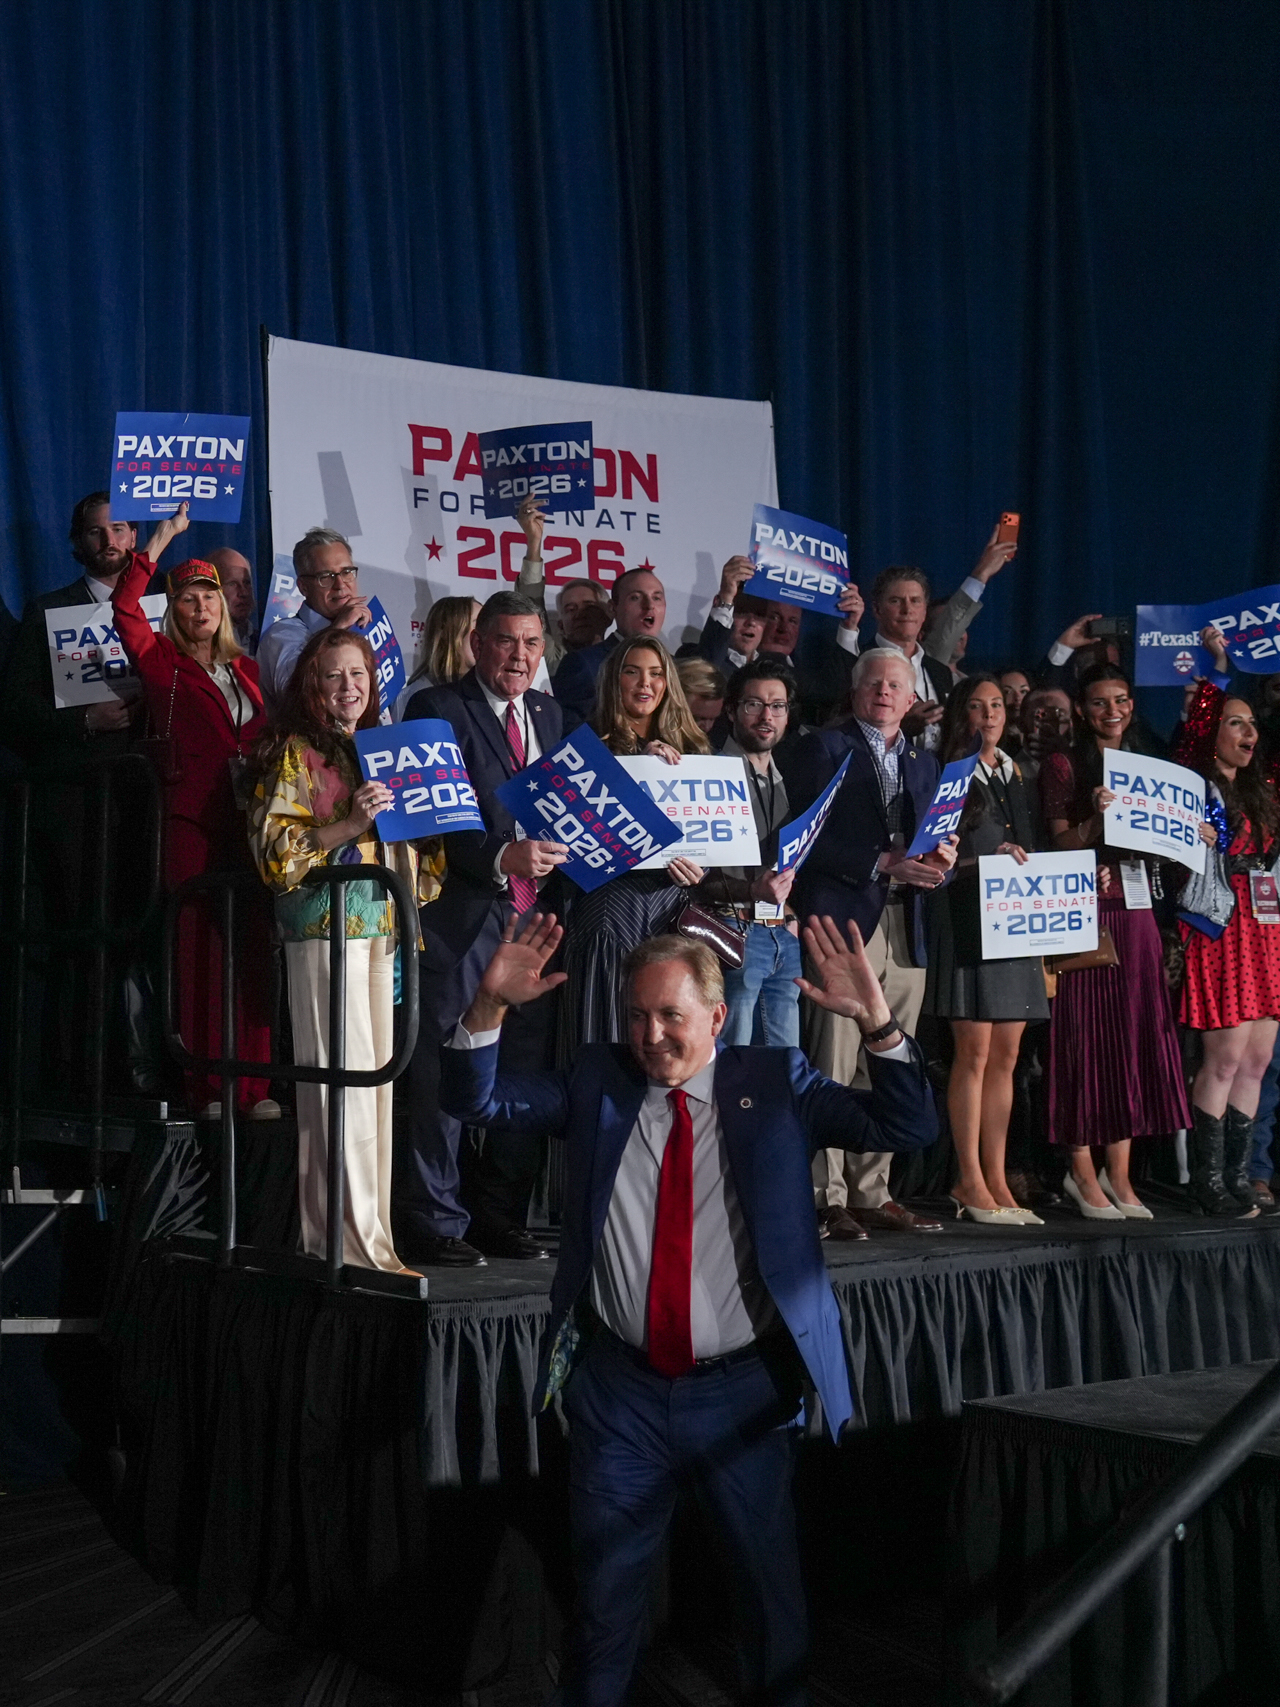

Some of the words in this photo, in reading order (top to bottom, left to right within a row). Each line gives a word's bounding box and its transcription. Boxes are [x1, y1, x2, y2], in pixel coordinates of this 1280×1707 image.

[117, 435, 244, 461] PAXTON
[482, 440, 590, 469] PAXTON
[116, 462, 151, 472] FOR
[160, 462, 242, 475] SENATE
[408, 423, 659, 503] PAON
[132, 475, 218, 499] 2026
[498, 474, 571, 499] 2026
[456, 525, 626, 590] 2026
[755, 522, 848, 569] PAXTON
[766, 563, 837, 596] 2026
[1209, 602, 1280, 635] PAX
[57, 650, 98, 663] FOR
[364, 742, 466, 777] PAXT
[388, 773, 422, 789] OR
[638, 779, 747, 802] AXTON
[933, 776, 973, 804] PAX
[1109, 770, 1205, 818] PAXTON
[402, 782, 478, 815] 202
[552, 742, 661, 855] PAXTON
[666, 805, 750, 816] SENATE
[929, 805, 956, 815] FOR
[1112, 794, 1147, 808] OR
[1157, 802, 1202, 826] SENAT
[541, 762, 577, 803] FOR
[581, 810, 638, 866] SENATE
[931, 809, 962, 835] 20
[1130, 809, 1195, 847] 2026
[534, 794, 614, 868] 2026
[985, 872, 1094, 899] PAXTON
[986, 901, 1022, 912] FOR
[1034, 896, 1095, 909] SENATE
[1007, 910, 1083, 935] 2026
